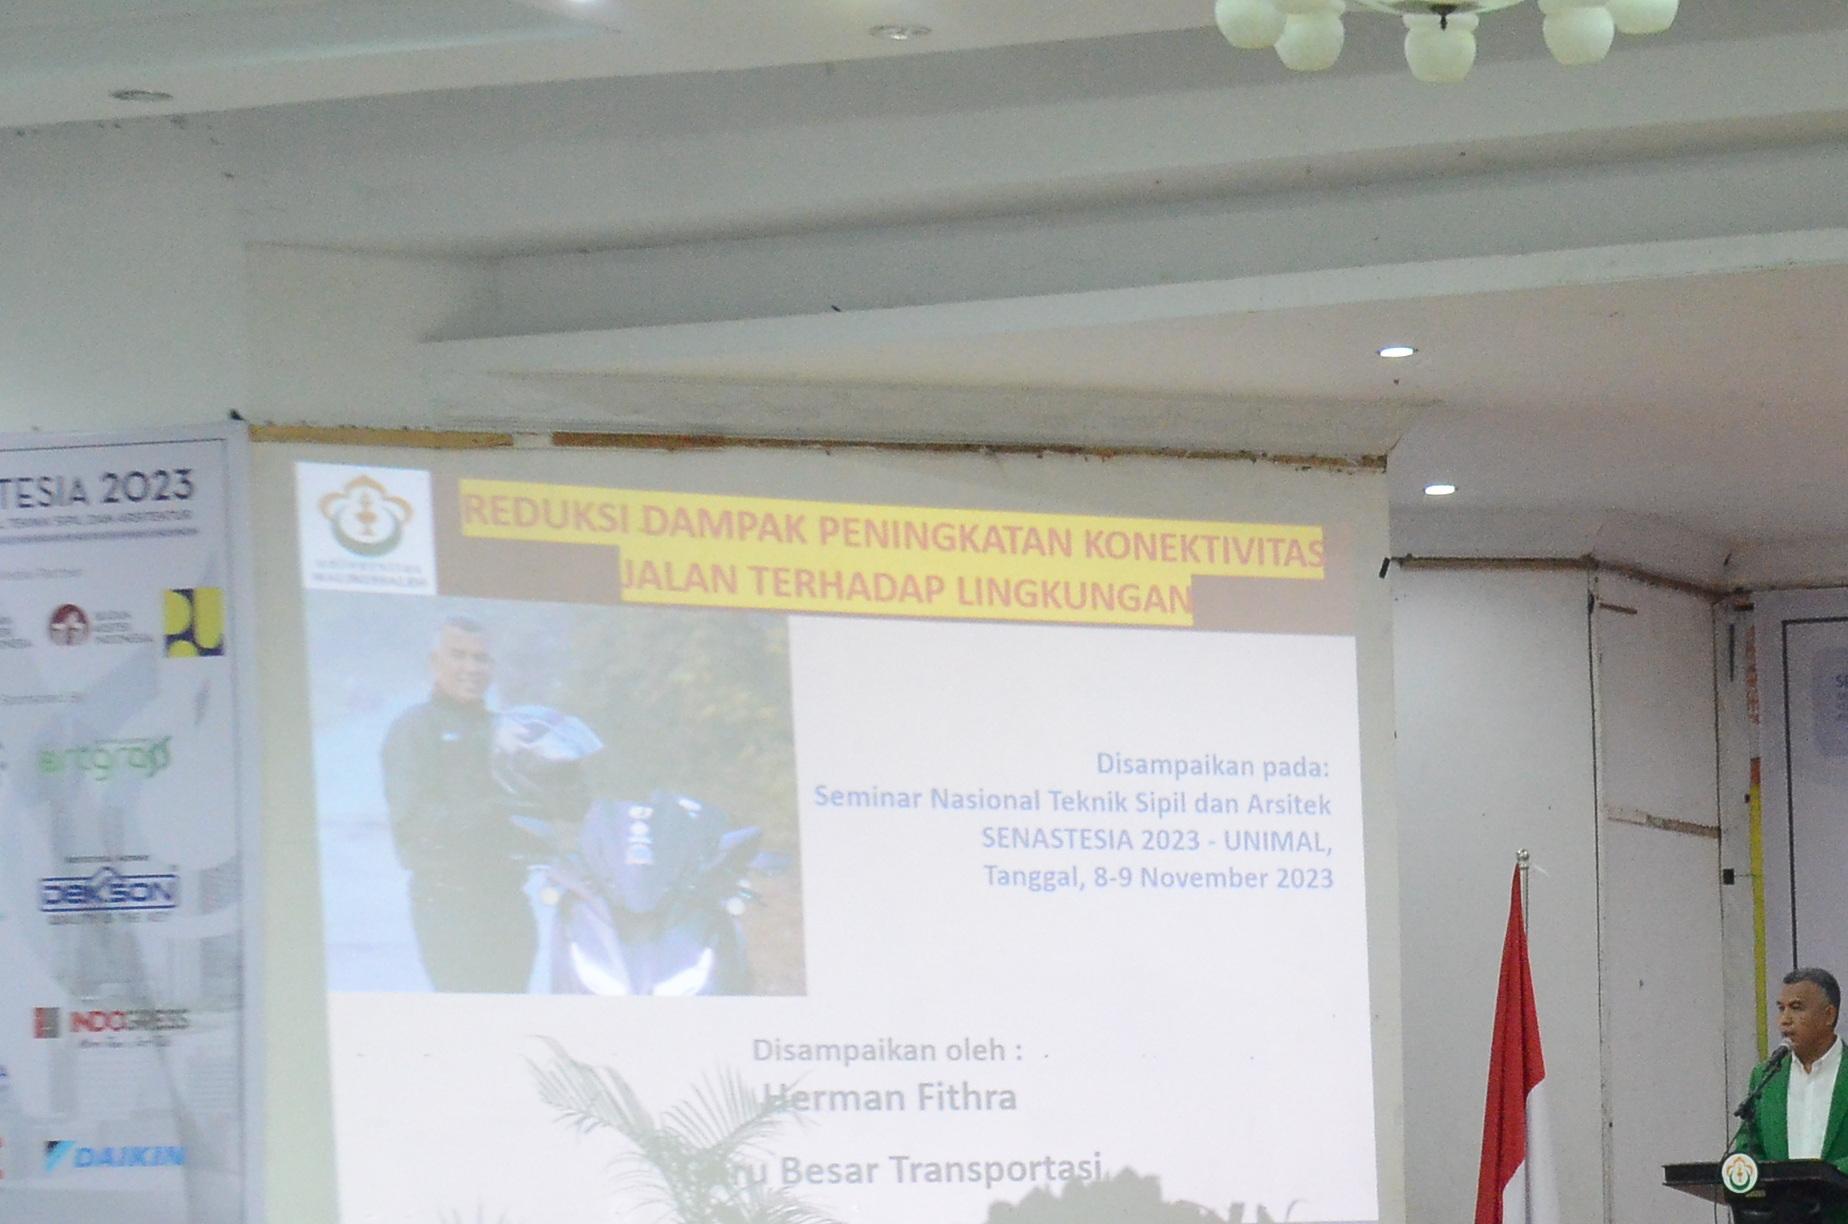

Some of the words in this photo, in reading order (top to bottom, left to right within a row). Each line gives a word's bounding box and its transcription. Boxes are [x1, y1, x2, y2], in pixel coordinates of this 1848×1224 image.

[101, 468, 194, 503] 2023
[462, 493, 629, 534] REDUKSI
[642, 505, 807, 545] DAMPAK
[819, 516, 1073, 558] PENINGKATAN
[1084, 529, 1326, 569] KONEKTIVITAS
[619, 558, 738, 595] JALAN
[748, 565, 945, 605] TERHADAP
[956, 575, 1193, 615] LINGKUNGAN
[1097, 753, 1255, 780] Disampaikan
[1262, 756, 1330, 781] pada:
[814, 785, 922, 809] Seminar
[931, 788, 1040, 811] Nasional
[1048, 790, 1128, 813] Teknik
[1136, 792, 1186, 818] Sipil
[1195, 793, 1239, 815] dan
[1247, 794, 1332, 816] Arsitek
[982, 827, 1133, 851] SENASTESIA
[1141, 829, 1200, 851] 2023
[1224, 830, 1333, 856] UNIMAL,
[984, 865, 1085, 892] Tanggal,
[1094, 866, 1132, 888] 8-9
[1140, 867, 1268, 889] November
[1276, 868, 1334, 889] 2023
[753, 1038, 936, 1066] Disampaikan
[945, 1038, 1005, 1062] oleh
[764, 1083, 905, 1112] Herman
[918, 1081, 1017, 1112] Fithra
[74, 1146, 186, 1168] DAIKIN
[782, 1156, 880, 1185] Besar
[888, 1151, 1102, 1189] Transportasi
